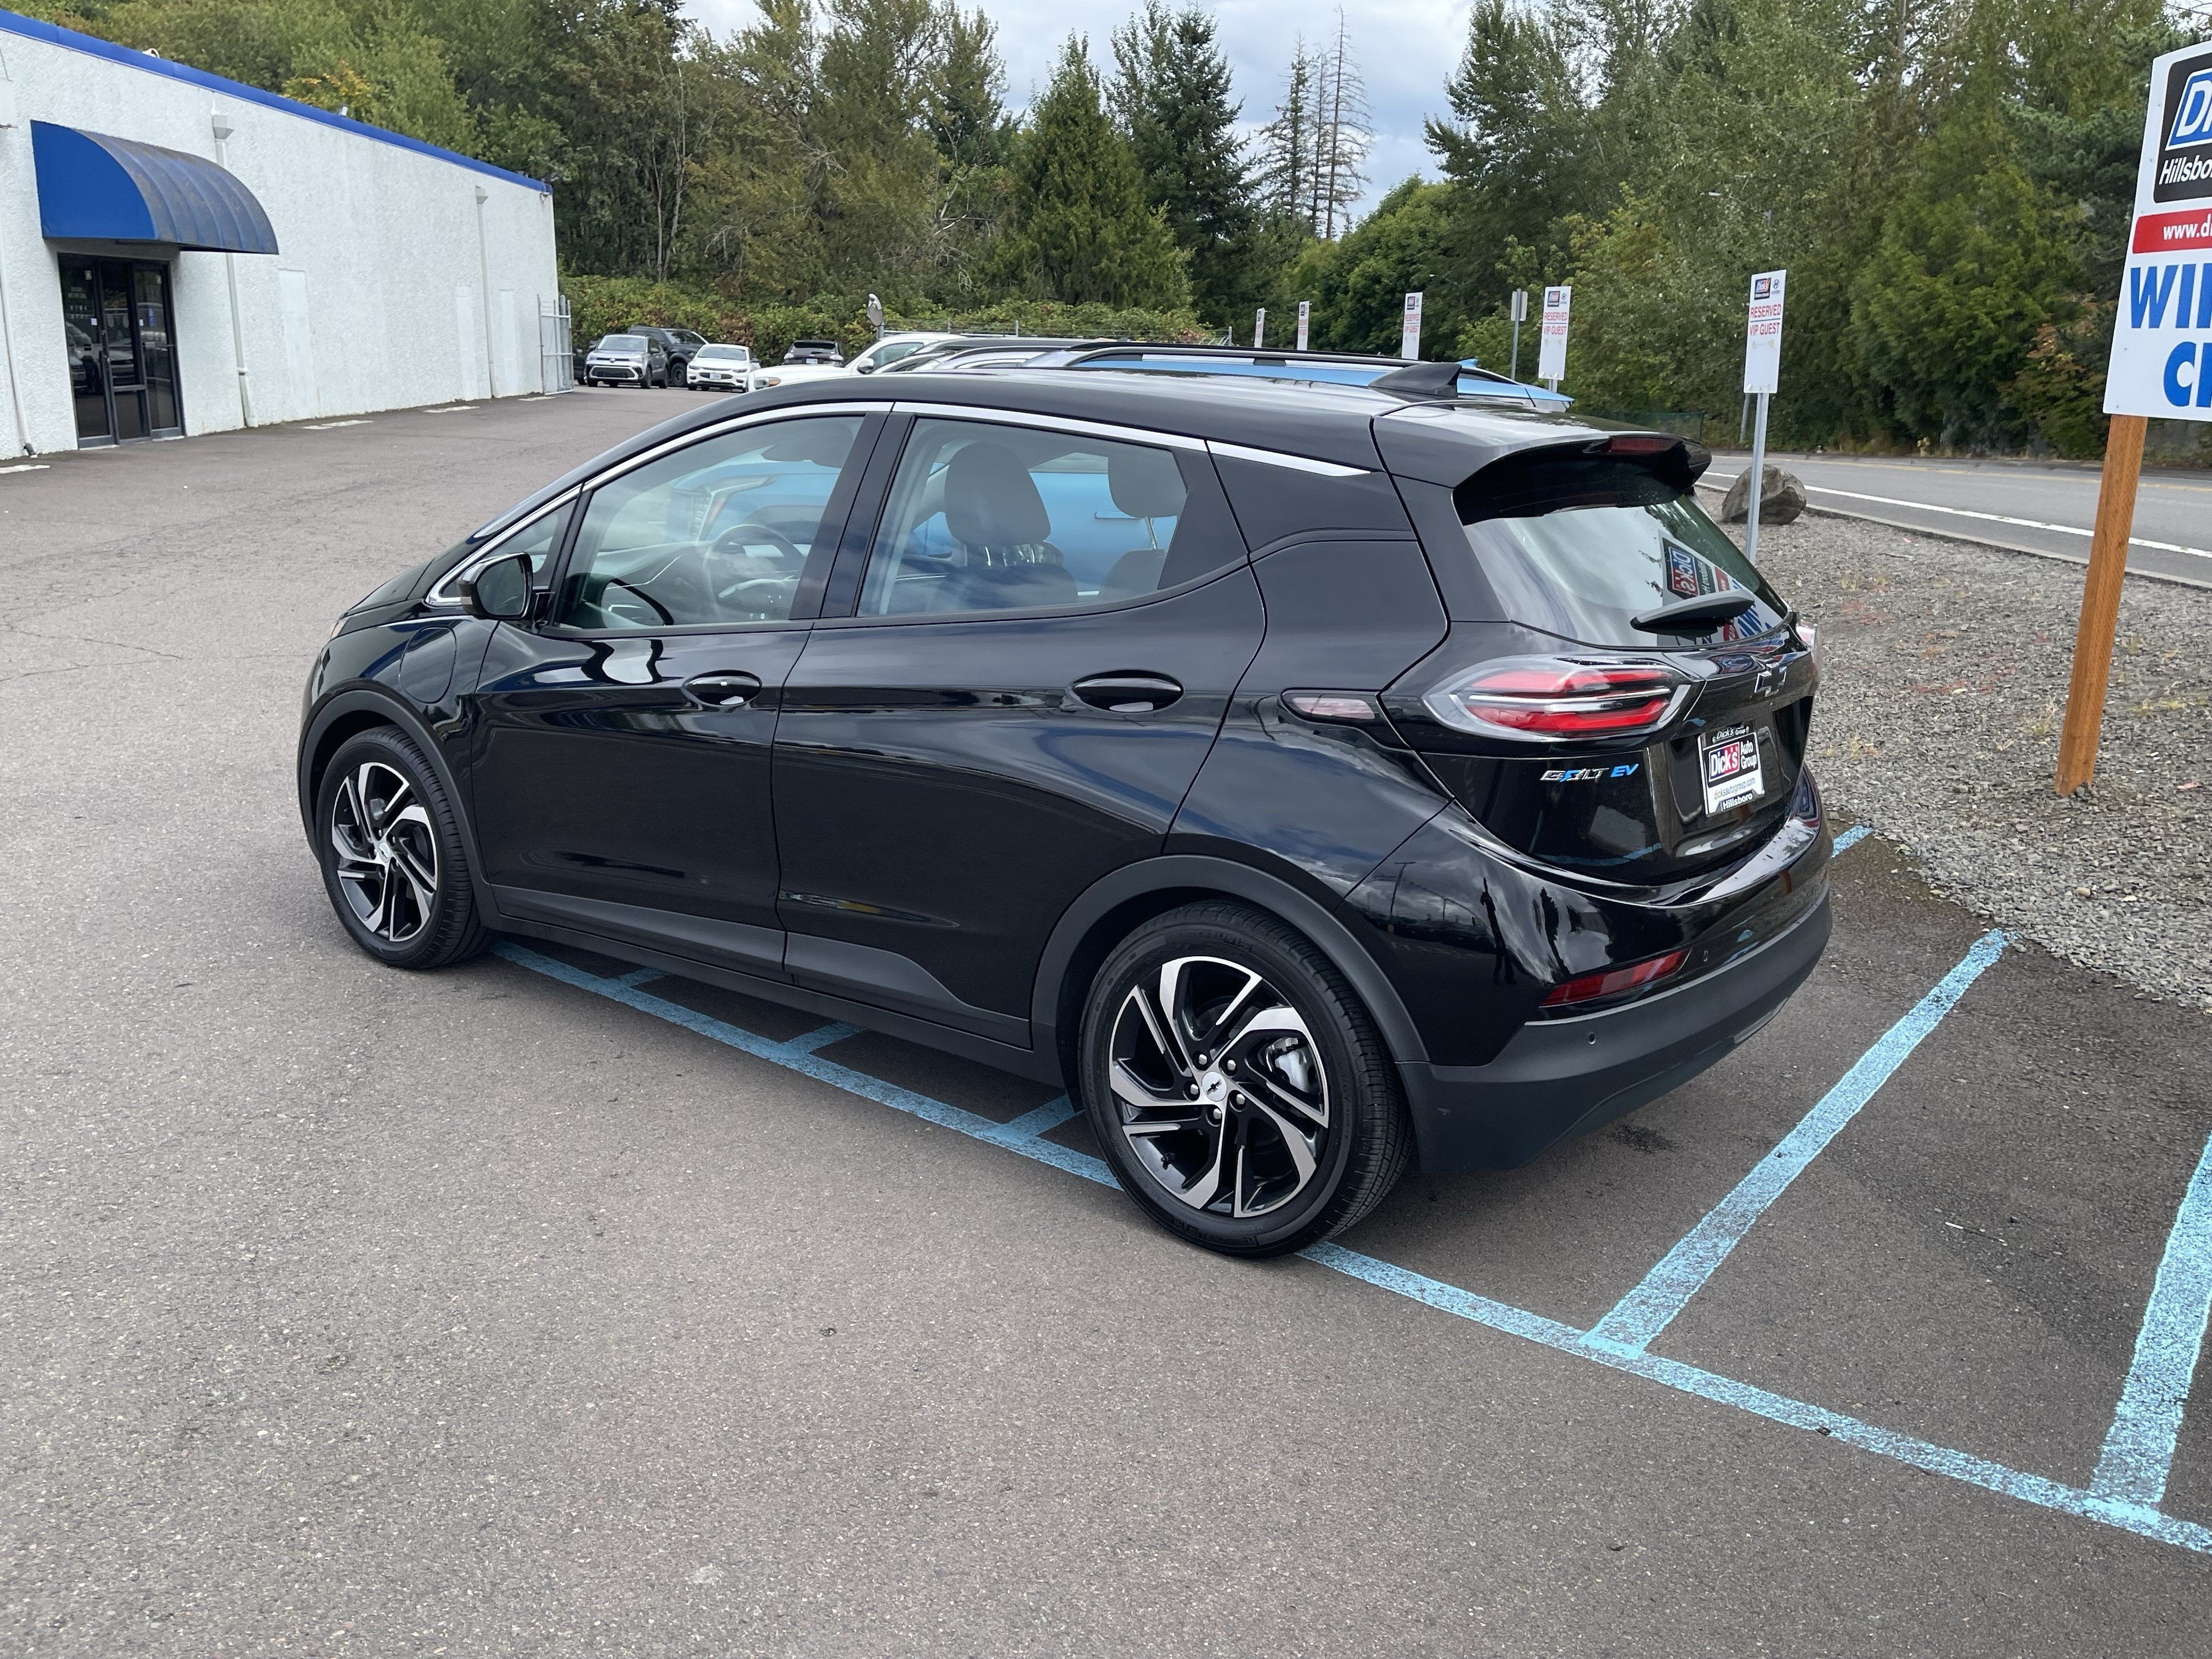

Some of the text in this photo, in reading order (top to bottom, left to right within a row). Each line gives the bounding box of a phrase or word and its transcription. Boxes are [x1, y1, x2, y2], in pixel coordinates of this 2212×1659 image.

[2159, 155, 2212, 185] Hillsbo
[1750, 304, 1781, 318] RESERVED
[1750, 323, 1780, 336] VIP GUEST
[1740, 740, 1753, 755] Auto
[1710, 745, 1739, 777] Dick's
[1741, 754, 1757, 769] Group
[1610, 764, 1640, 778] EV
[1714, 777, 1756, 800] dicksautogroup.com
[1723, 793, 1753, 810] Hillsboro
